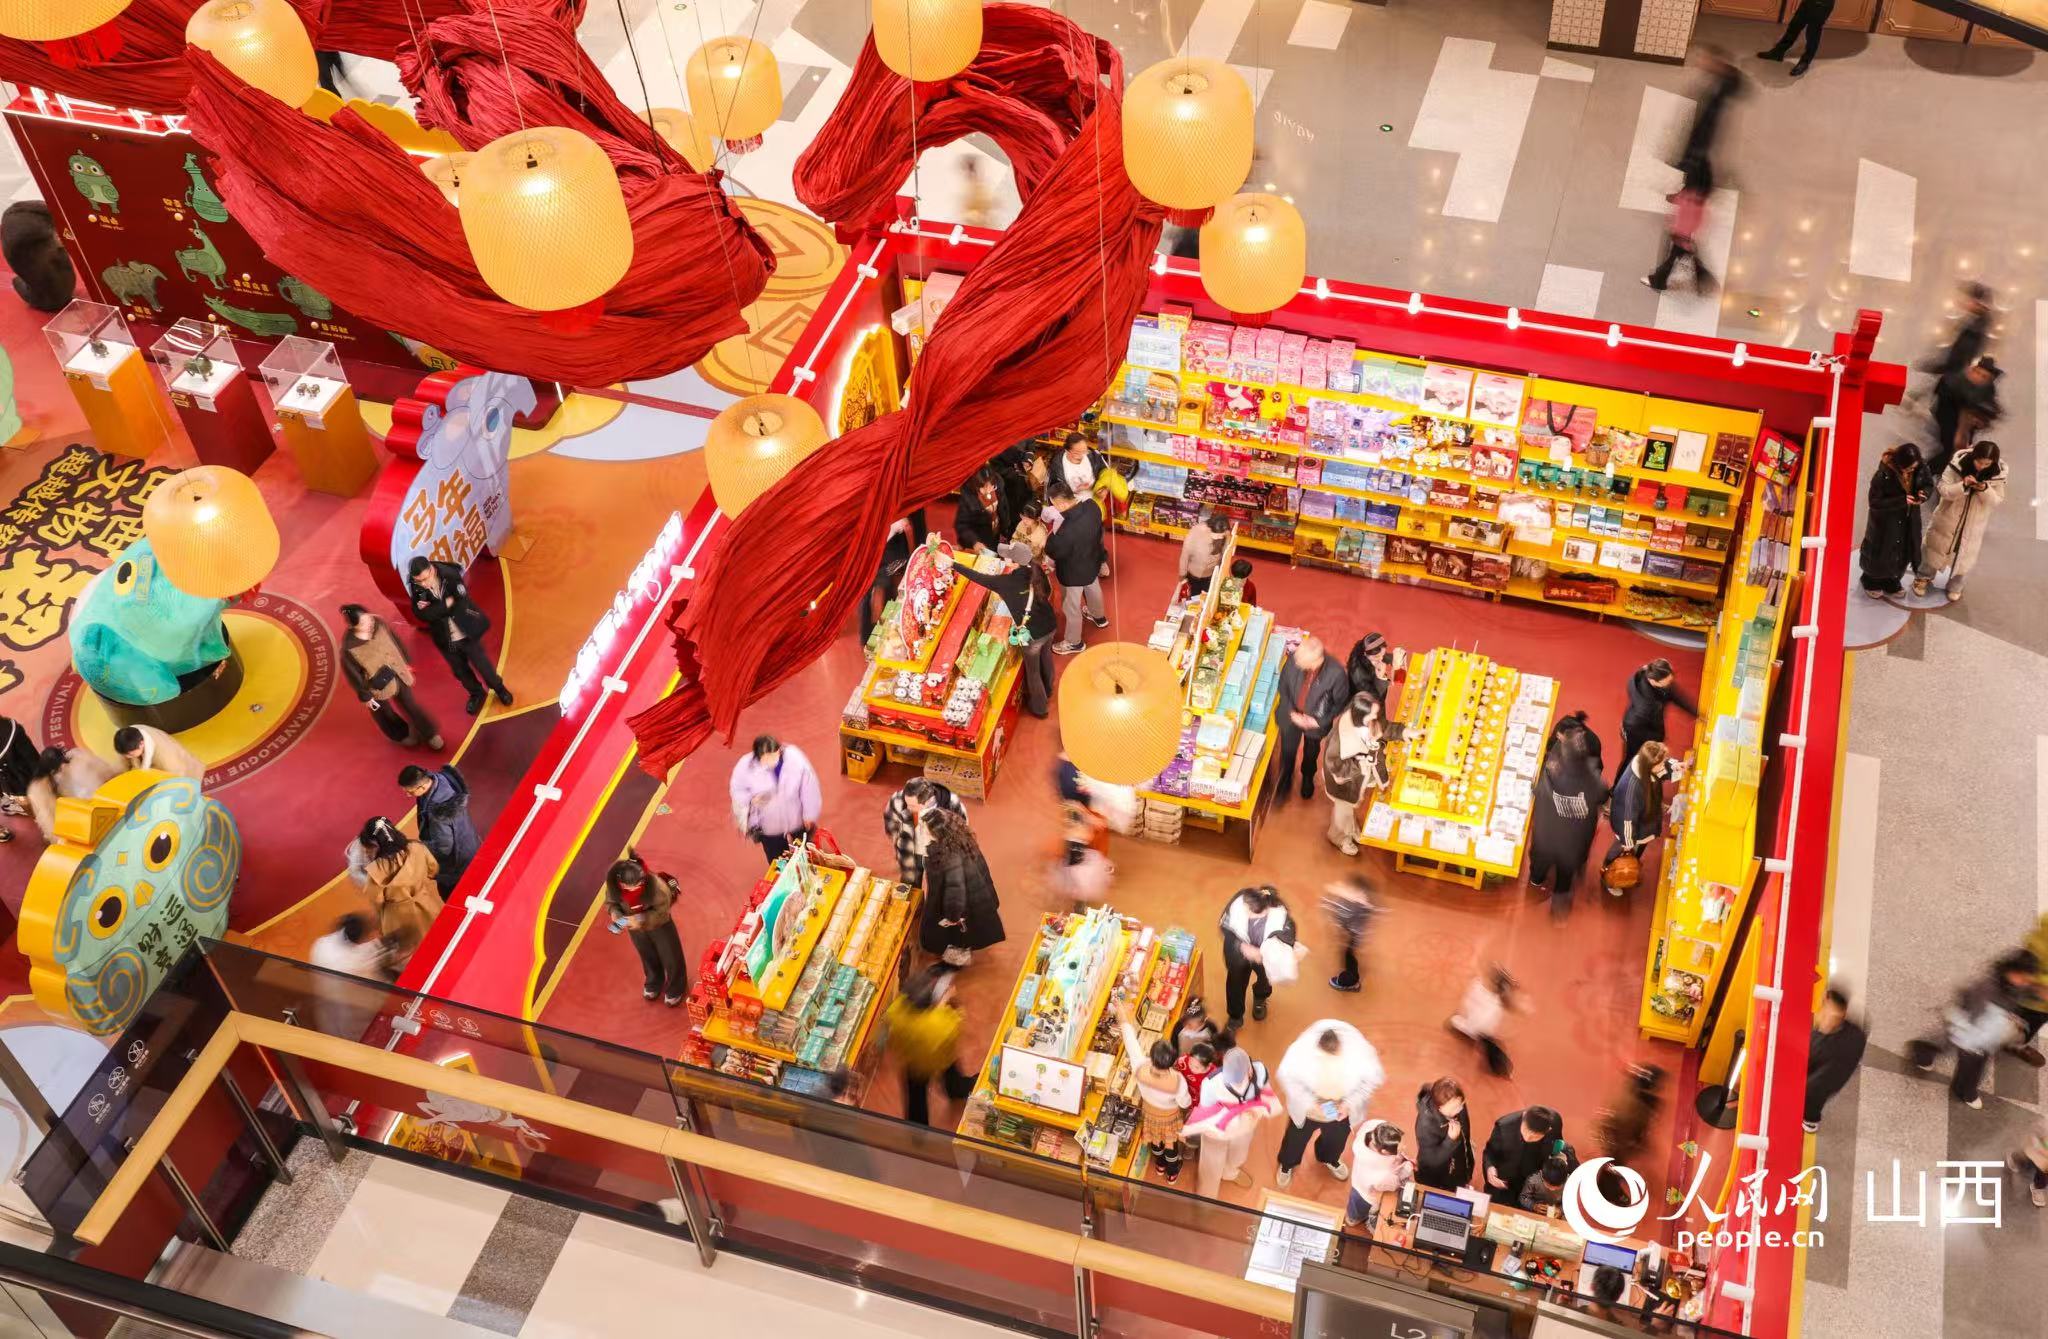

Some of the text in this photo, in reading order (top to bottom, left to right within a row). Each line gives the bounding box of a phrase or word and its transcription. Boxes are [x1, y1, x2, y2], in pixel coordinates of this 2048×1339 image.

[38, 459, 139, 547] 文物
[403, 469, 473, 549] 马年
[49, 681, 75, 740] FESTIVAL
[203, 604, 329, 786] A SPRING FESTIVAL TRAVELOGUE IN
